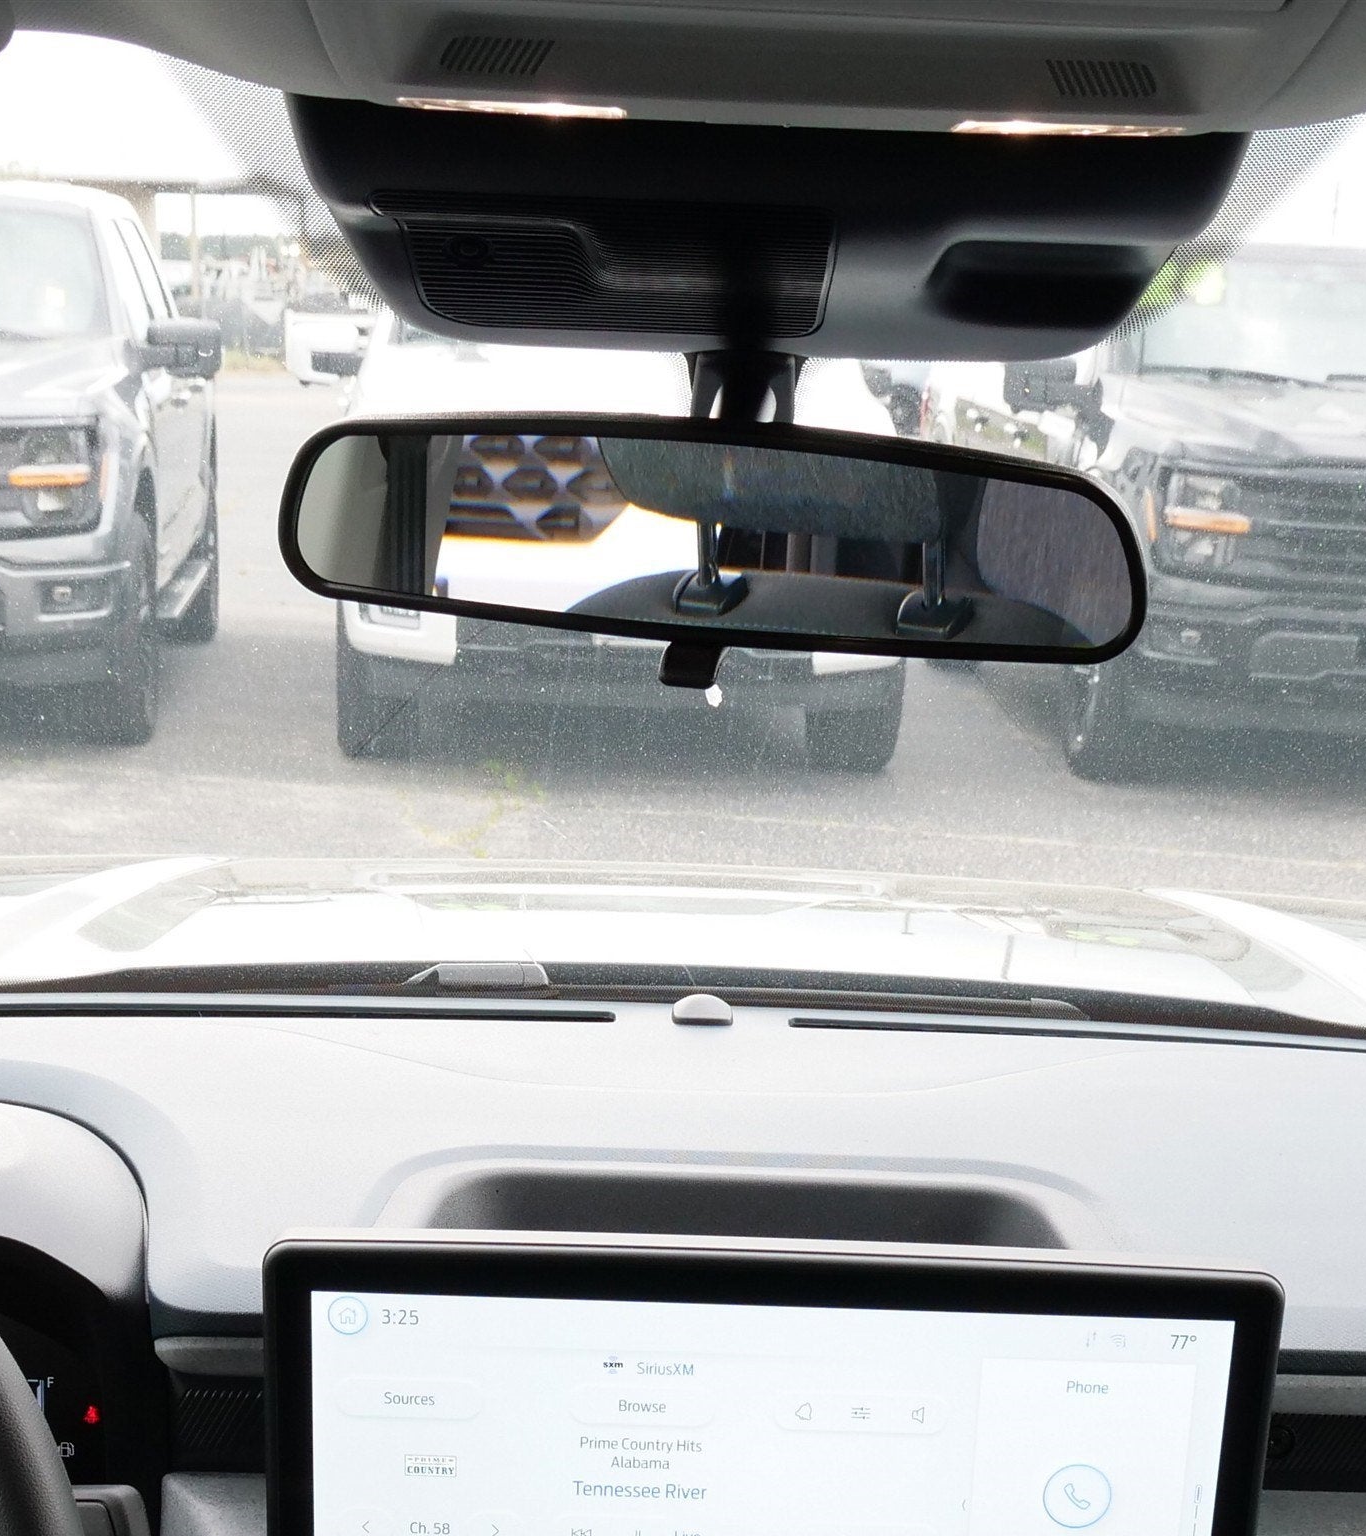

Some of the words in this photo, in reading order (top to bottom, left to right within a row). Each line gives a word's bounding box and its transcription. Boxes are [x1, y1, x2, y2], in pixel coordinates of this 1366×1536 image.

[382, 1308, 420, 1326] 3:25
[1170, 1334, 1197, 1350] 77°
[603, 1360, 624, 1369] sxm
[636, 1362, 695, 1377] SiriusXM
[47, 1376, 54, 1388] F
[1066, 1380, 1109, 1394] Phone
[384, 1391, 435, 1406] Sources
[618, 1399, 667, 1414] Browse
[580, 1436, 619, 1451] Prime
[621, 1437, 673, 1455] Country
[676, 1440, 703, 1453] Hits
[407, 1465, 454, 1475] COUNTRY
[610, 1456, 671, 1470] Alabama
[572, 1480, 662, 1499] Tennessee
[665, 1484, 707, 1500] River
[409, 1521, 430, 1535] Ch.
[433, 1522, 451, 1536] 58
